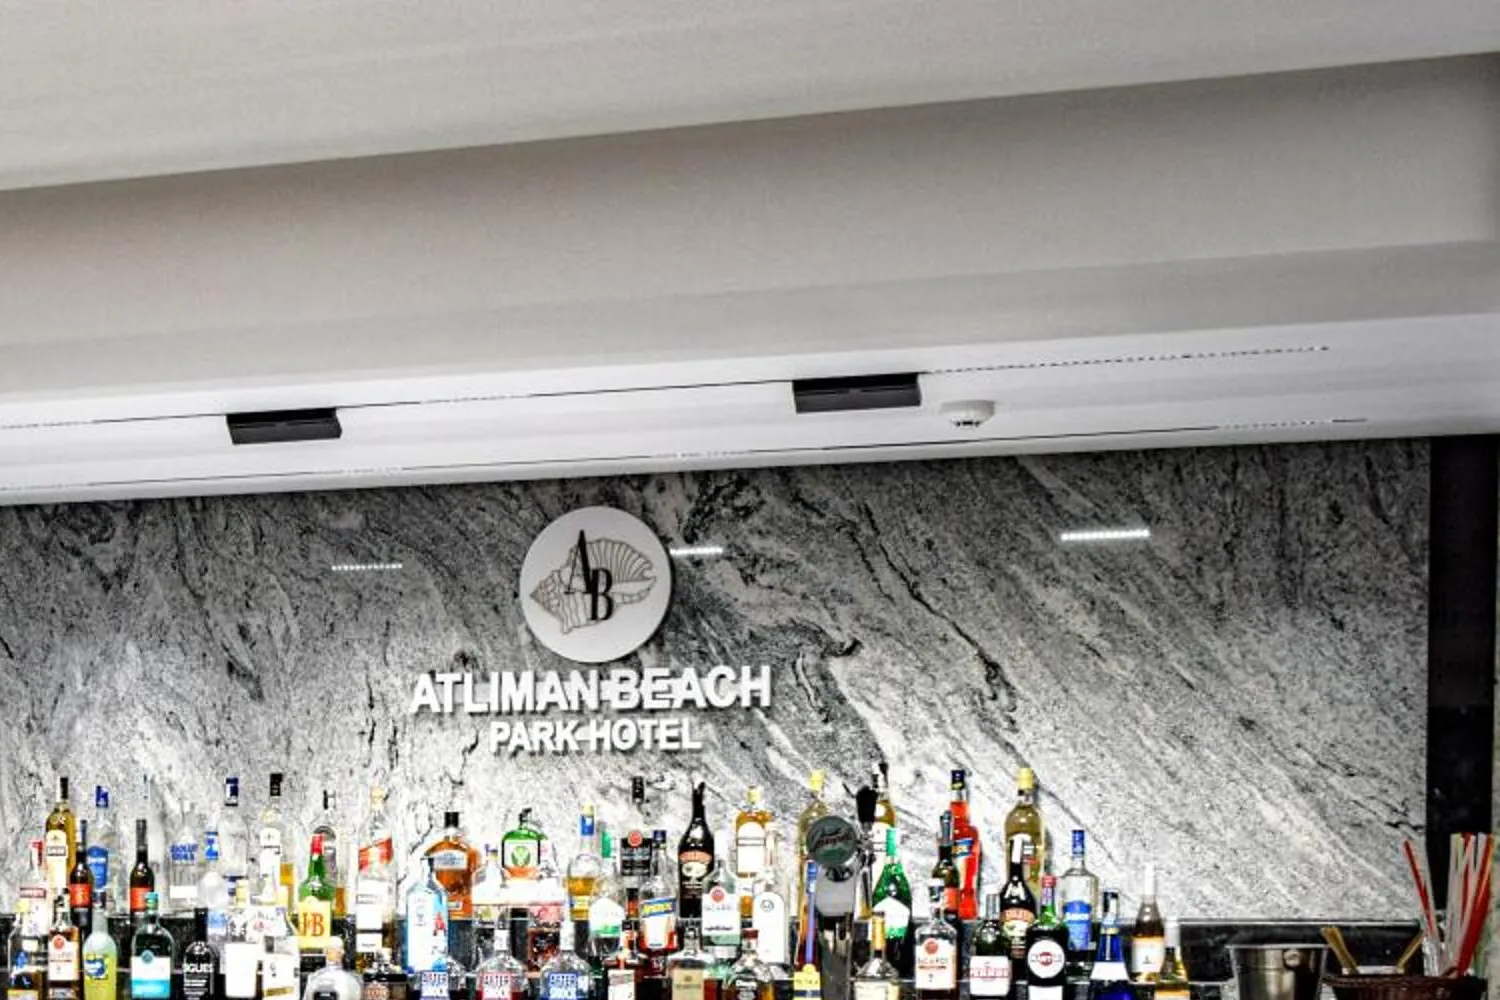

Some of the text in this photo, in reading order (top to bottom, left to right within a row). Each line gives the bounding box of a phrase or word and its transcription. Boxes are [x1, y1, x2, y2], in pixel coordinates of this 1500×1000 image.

[408, 665, 772, 713] ATLIMAN BEACH
[490, 718, 703, 751] PARK HOTEL
